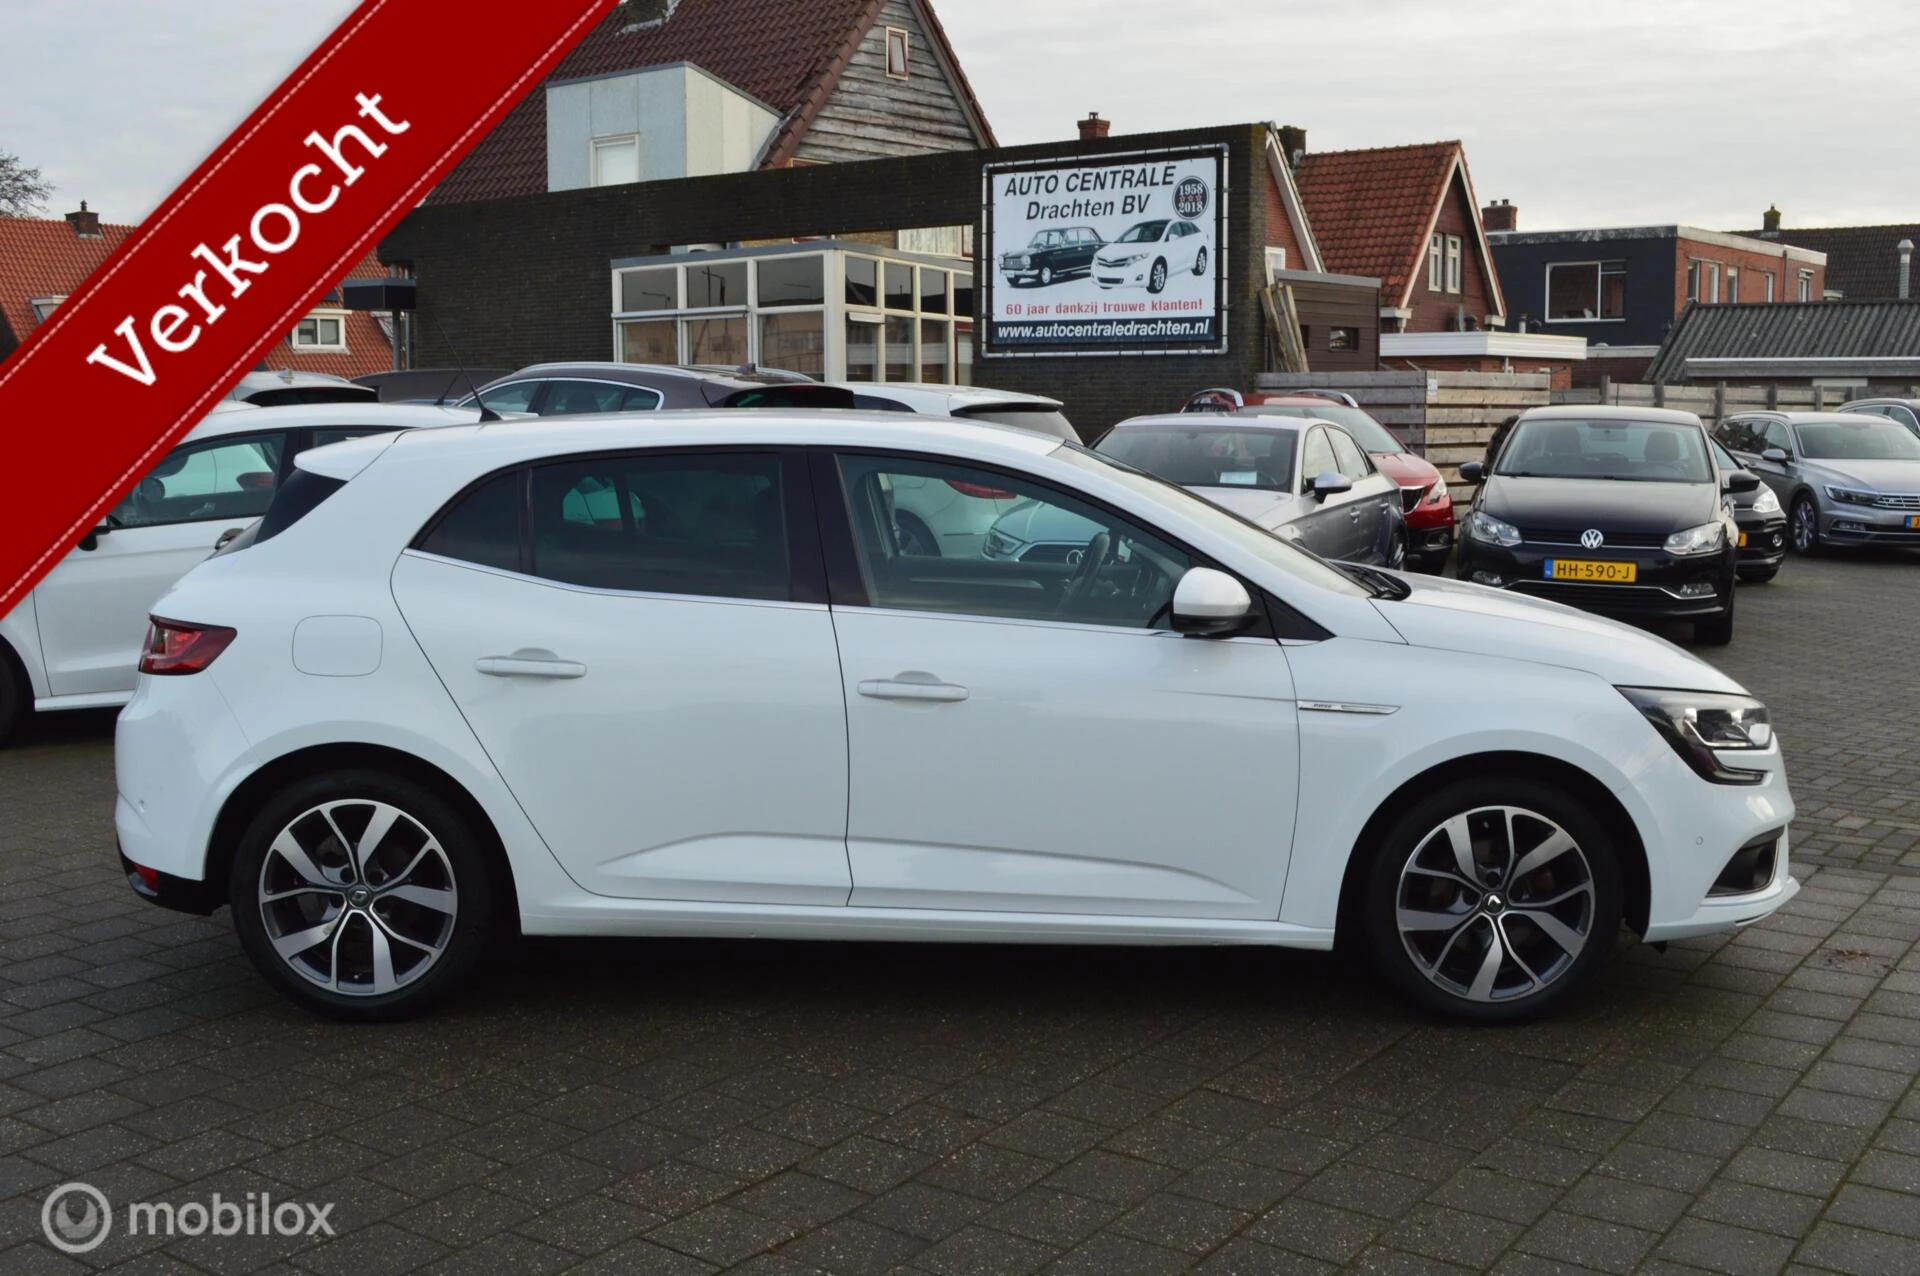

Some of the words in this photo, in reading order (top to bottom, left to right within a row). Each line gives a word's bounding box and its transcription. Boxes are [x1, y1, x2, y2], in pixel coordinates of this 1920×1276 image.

[1004, 174, 1059, 197] AUTO
[1065, 165, 1177, 193] CENTRALE
[1179, 183, 1204, 196] 1958
[1026, 200, 1115, 221] Drachten
[1121, 193, 1151, 215] BV
[1178, 200, 1203, 213] 2018
[1006, 303, 1022, 315] 60
[1027, 303, 1050, 316] jaar
[1055, 301, 1098, 316] dankzij
[1103, 301, 1146, 313] trouwe
[1151, 298, 1203, 312] klanten!
[997, 318, 1210, 339] www.autocentraledrachten.nl
[1556, 562, 1631, 579] HH-590-J
